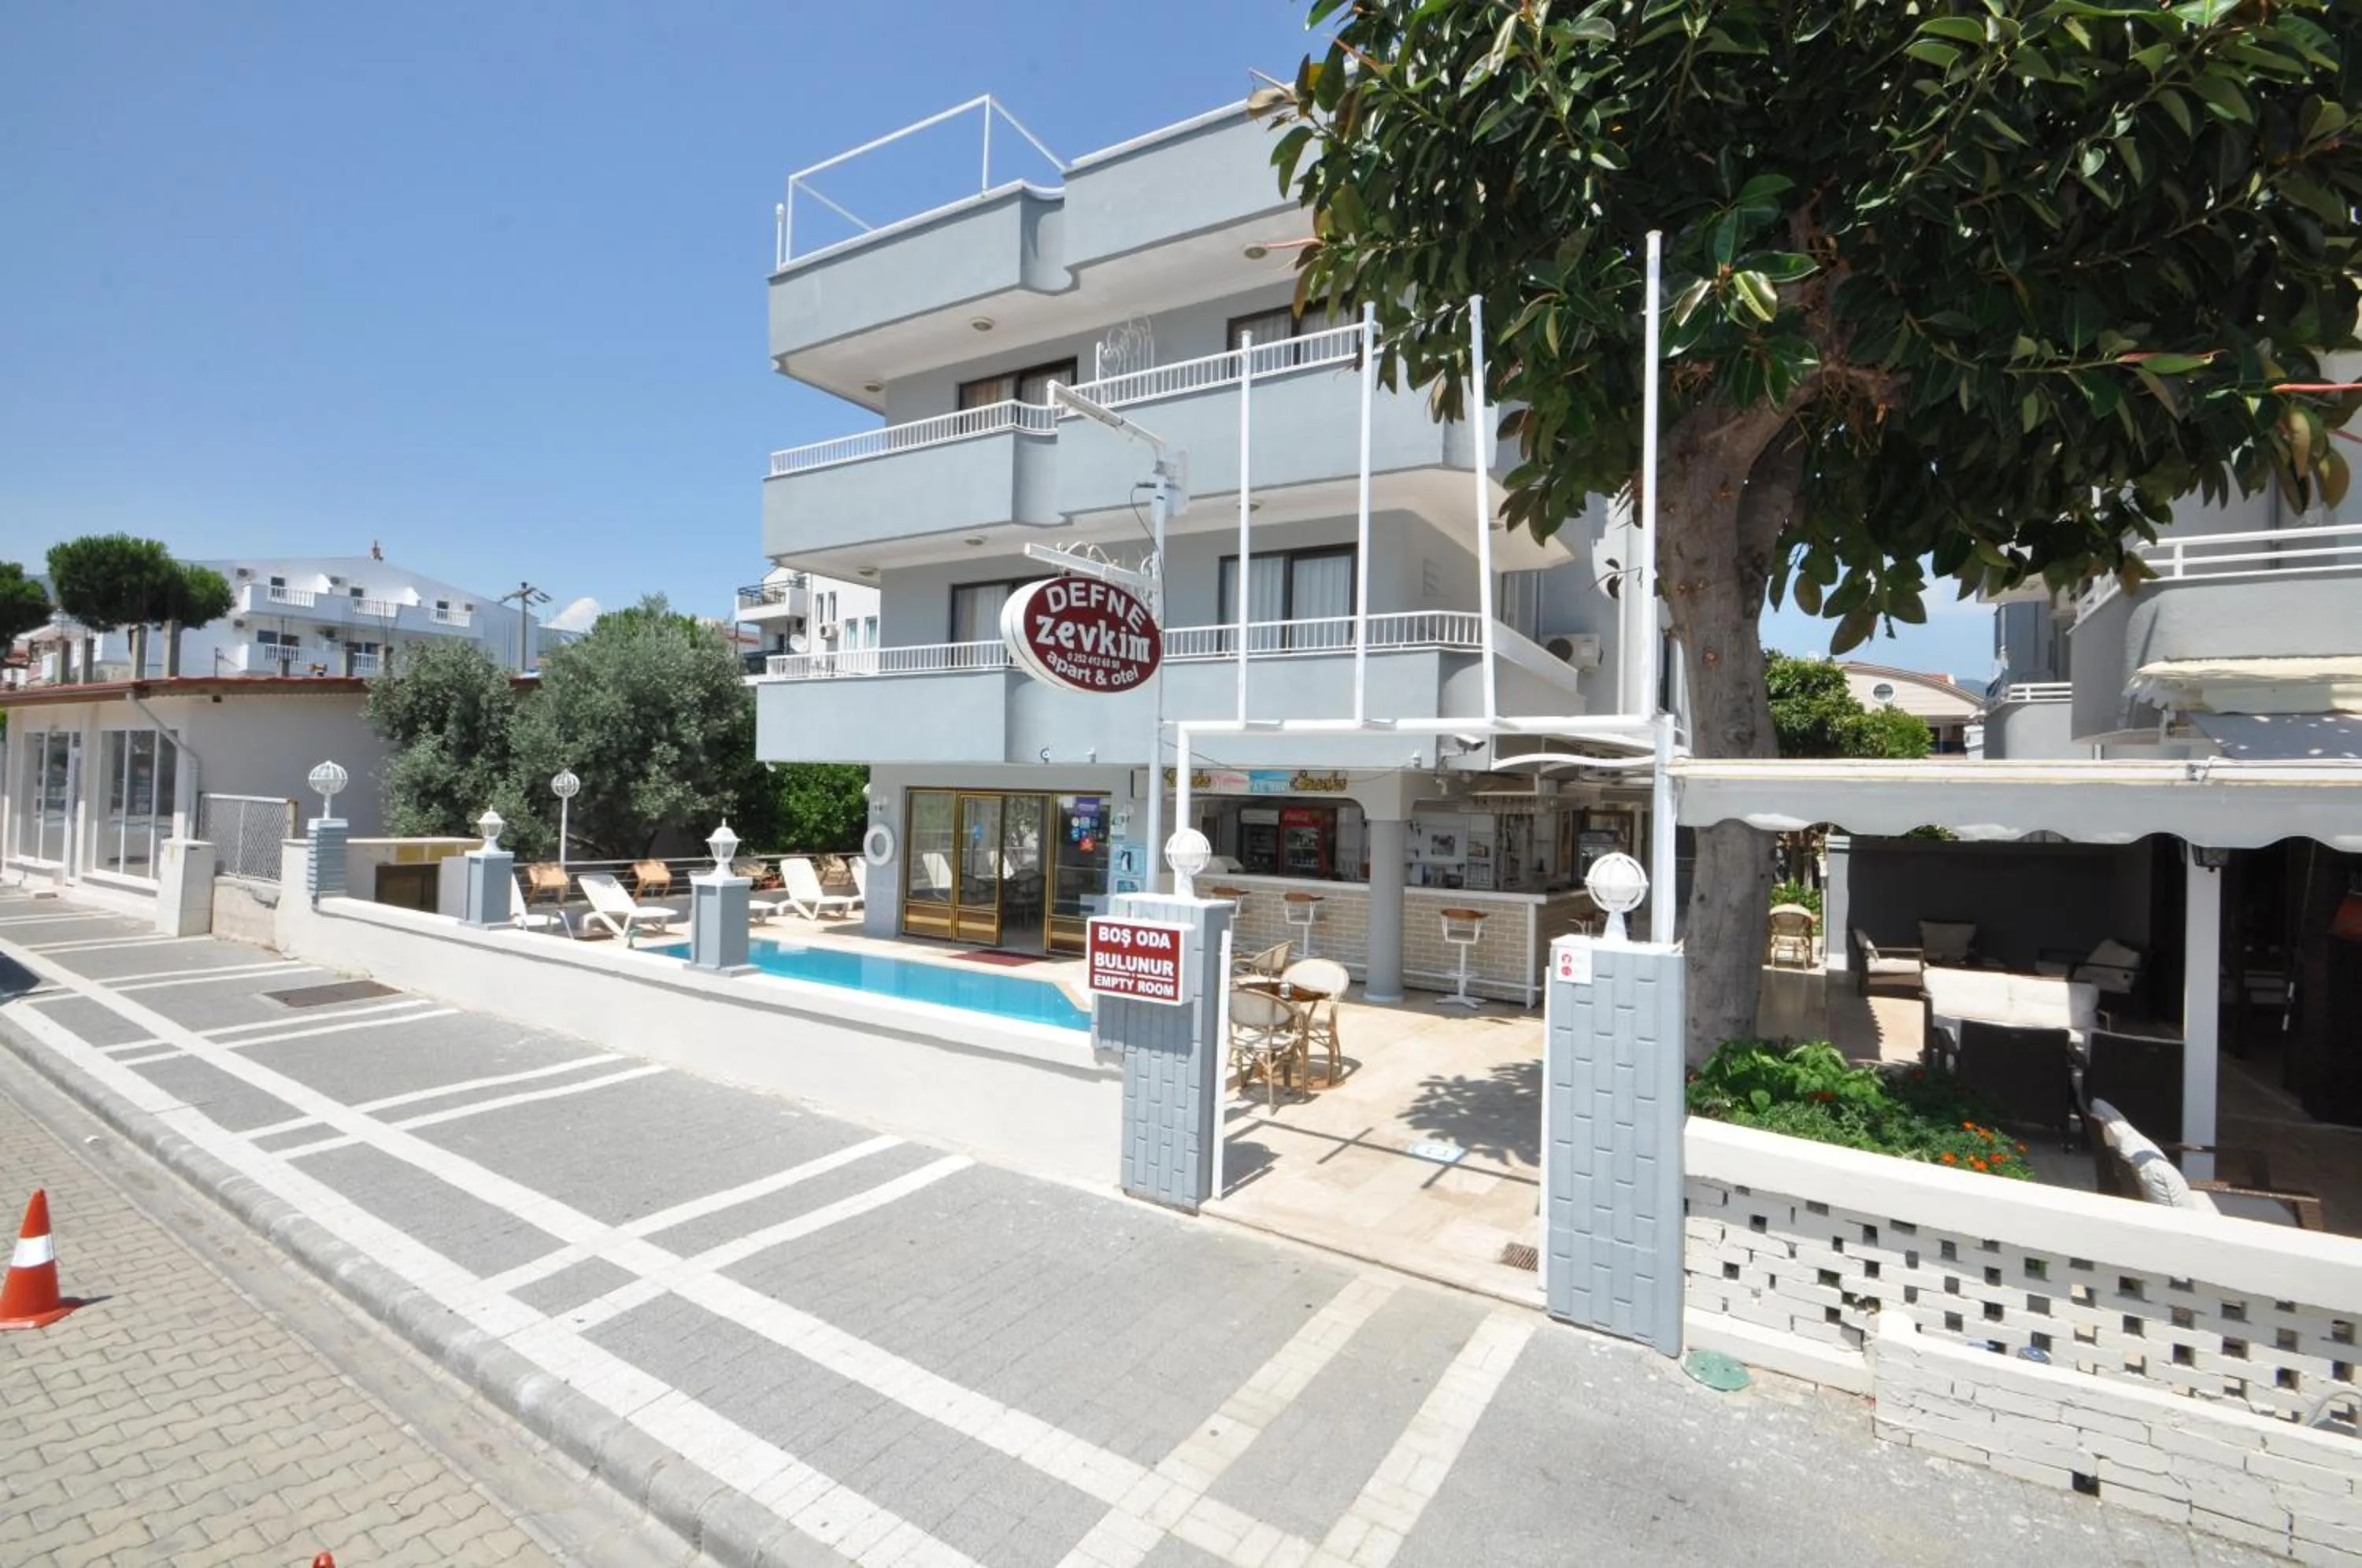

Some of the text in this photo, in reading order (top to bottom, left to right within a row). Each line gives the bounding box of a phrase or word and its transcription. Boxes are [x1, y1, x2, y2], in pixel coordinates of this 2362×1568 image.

[1046, 582, 1146, 634] DEFNE
[1046, 651, 1139, 686] apart & otel
[1098, 926, 1172, 949] BOŞ ODA
[1094, 952, 1174, 976] BULUNUR
[1094, 974, 1175, 997] EMPTY ROOM
